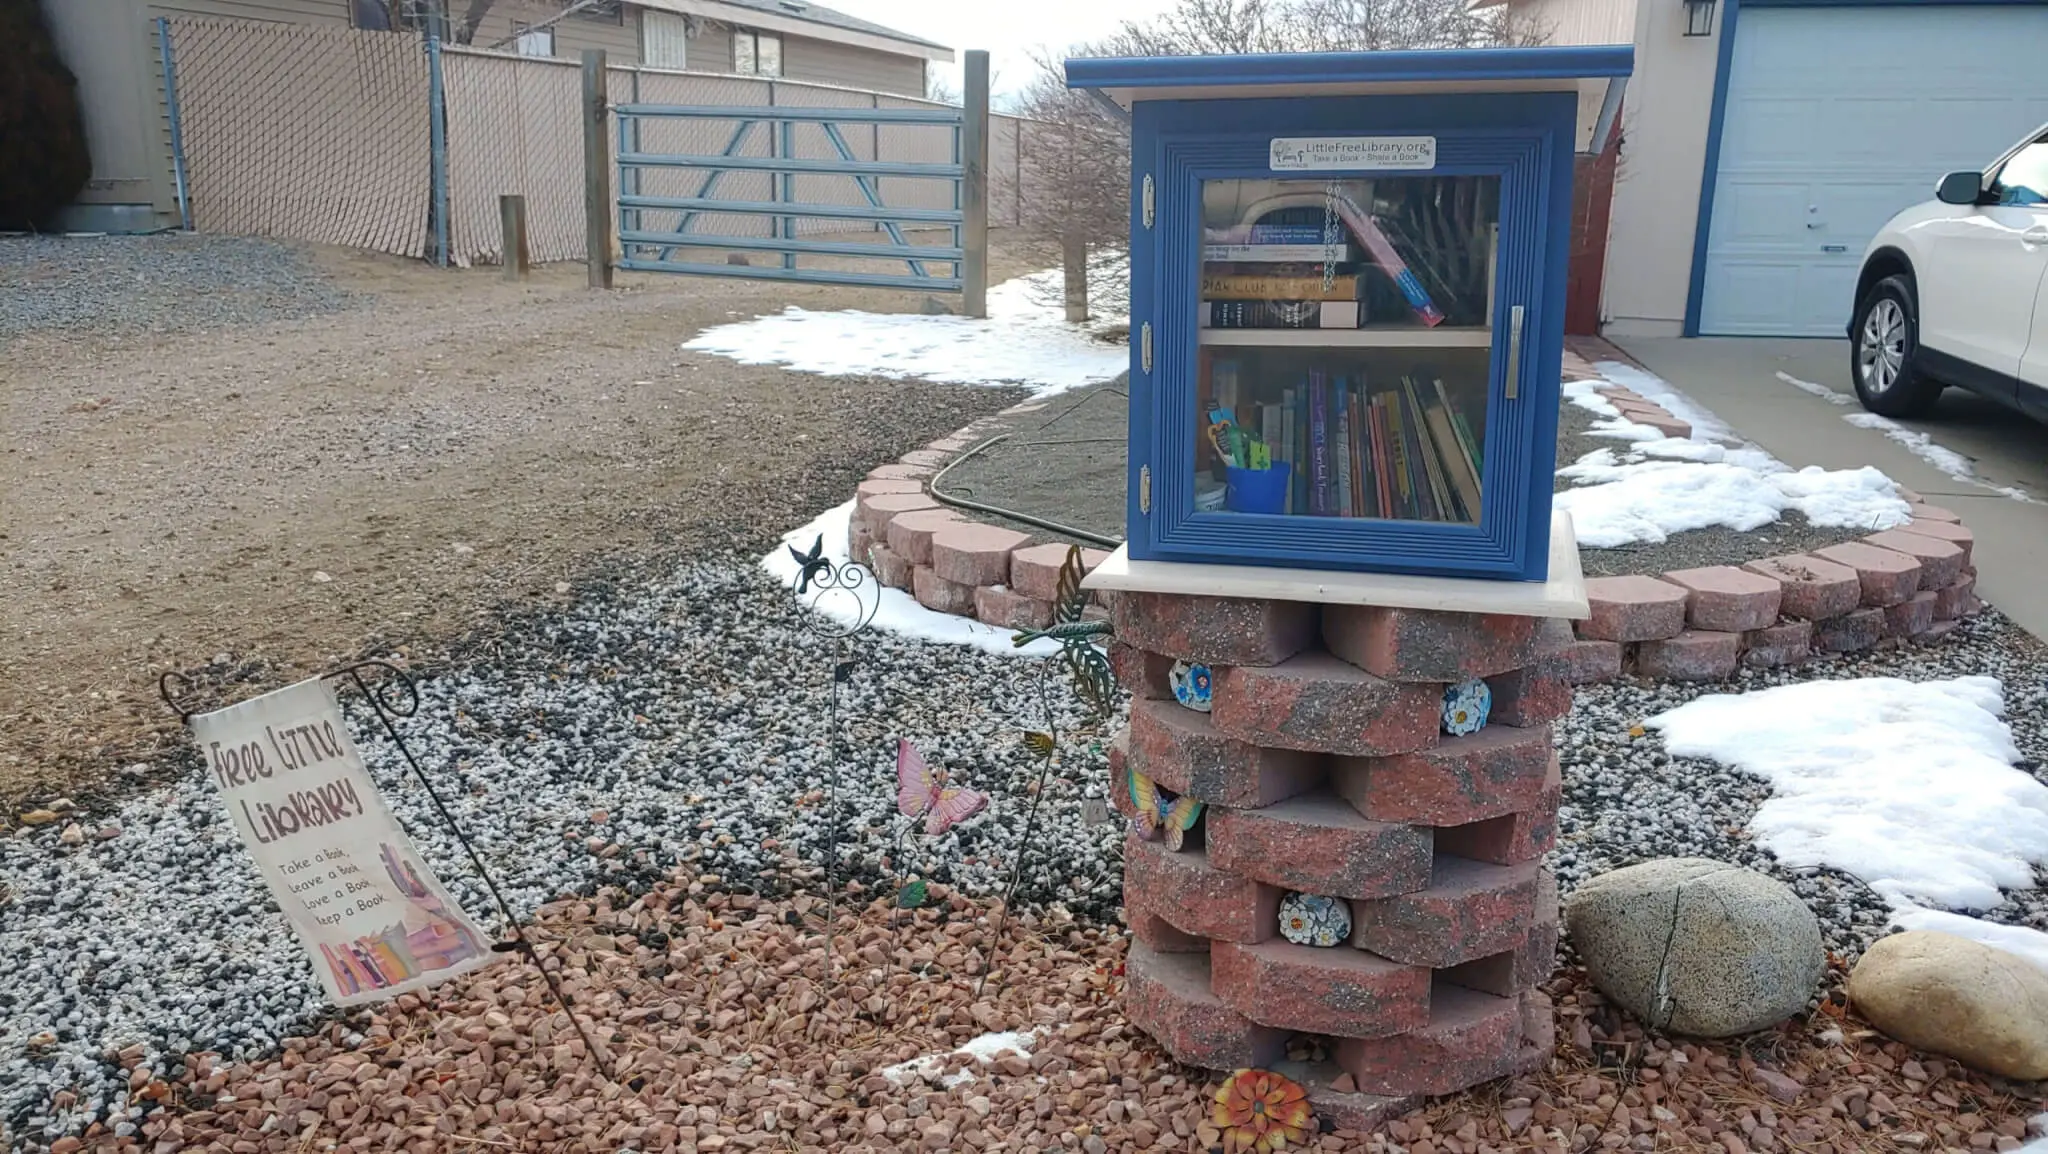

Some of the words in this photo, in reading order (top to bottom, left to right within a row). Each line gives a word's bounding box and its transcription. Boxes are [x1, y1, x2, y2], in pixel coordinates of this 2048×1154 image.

[1313, 154, 1330, 162] Take
[1340, 154, 1358, 162] Book
[1367, 152, 1390, 161] Share
[1399, 152, 1418, 160] Book
[279, 858, 312, 875] Take
[315, 853, 325, 863] a
[288, 875, 323, 893] Leave
[328, 871, 337, 879] a
[302, 894, 330, 910] Love
[335, 890, 344, 898] a
[345, 907, 354, 916] a
